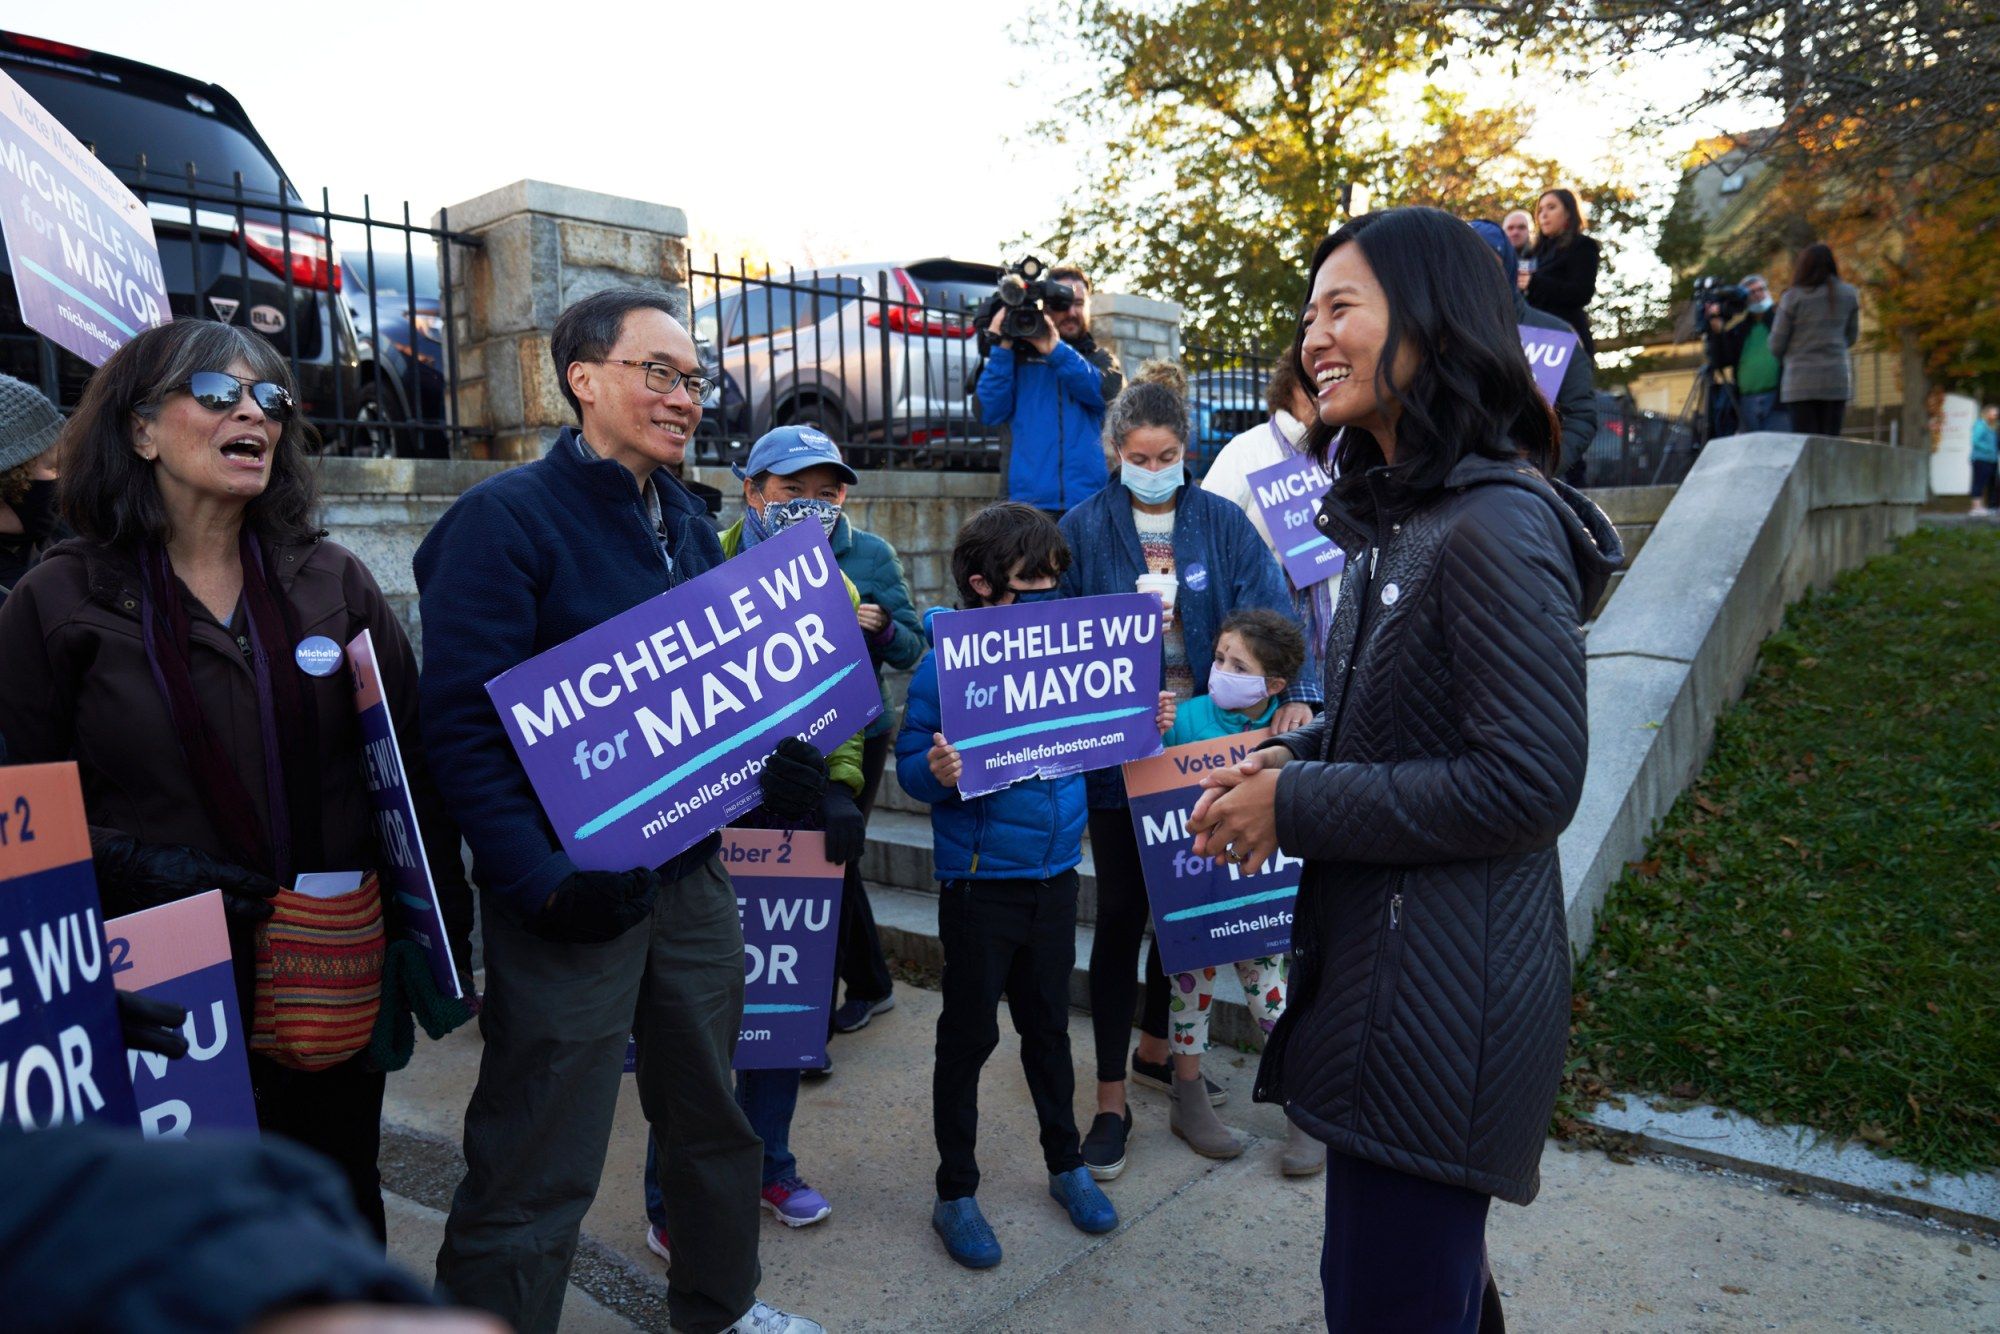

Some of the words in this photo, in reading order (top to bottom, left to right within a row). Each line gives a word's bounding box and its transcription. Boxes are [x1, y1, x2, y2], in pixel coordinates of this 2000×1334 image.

[11, 90, 50, 140] Vote
[51, 126, 120, 203] November
[0, 137, 127, 265] MICHELLE
[126, 240, 164, 296] WU
[21, 194, 54, 240] for
[58, 222, 161, 329] MAYOR
[252, 311, 281, 326] BLA
[1521, 342, 1566, 368] WU
[1284, 508, 1310, 530] for
[298, 649, 340, 658] Michelle
[511, 586, 762, 746] MICHELLE
[759, 546, 829, 610] WU
[942, 619, 1094, 671] MICHELLE
[1100, 614, 1156, 647] WU
[573, 729, 629, 780] for
[633, 612, 836, 758] MAYOR
[965, 681, 997, 710] for
[1003, 657, 1135, 714] MAYOR
[985, 732, 1125, 770] michelleforboston.com
[1174, 752, 1226, 775] Vote
[777, 843, 792, 863] 2
[1172, 850, 1216, 878] for
[759, 898, 831, 932] WU
[20, 908, 102, 1004] WU
[109, 937, 134, 975] 2
